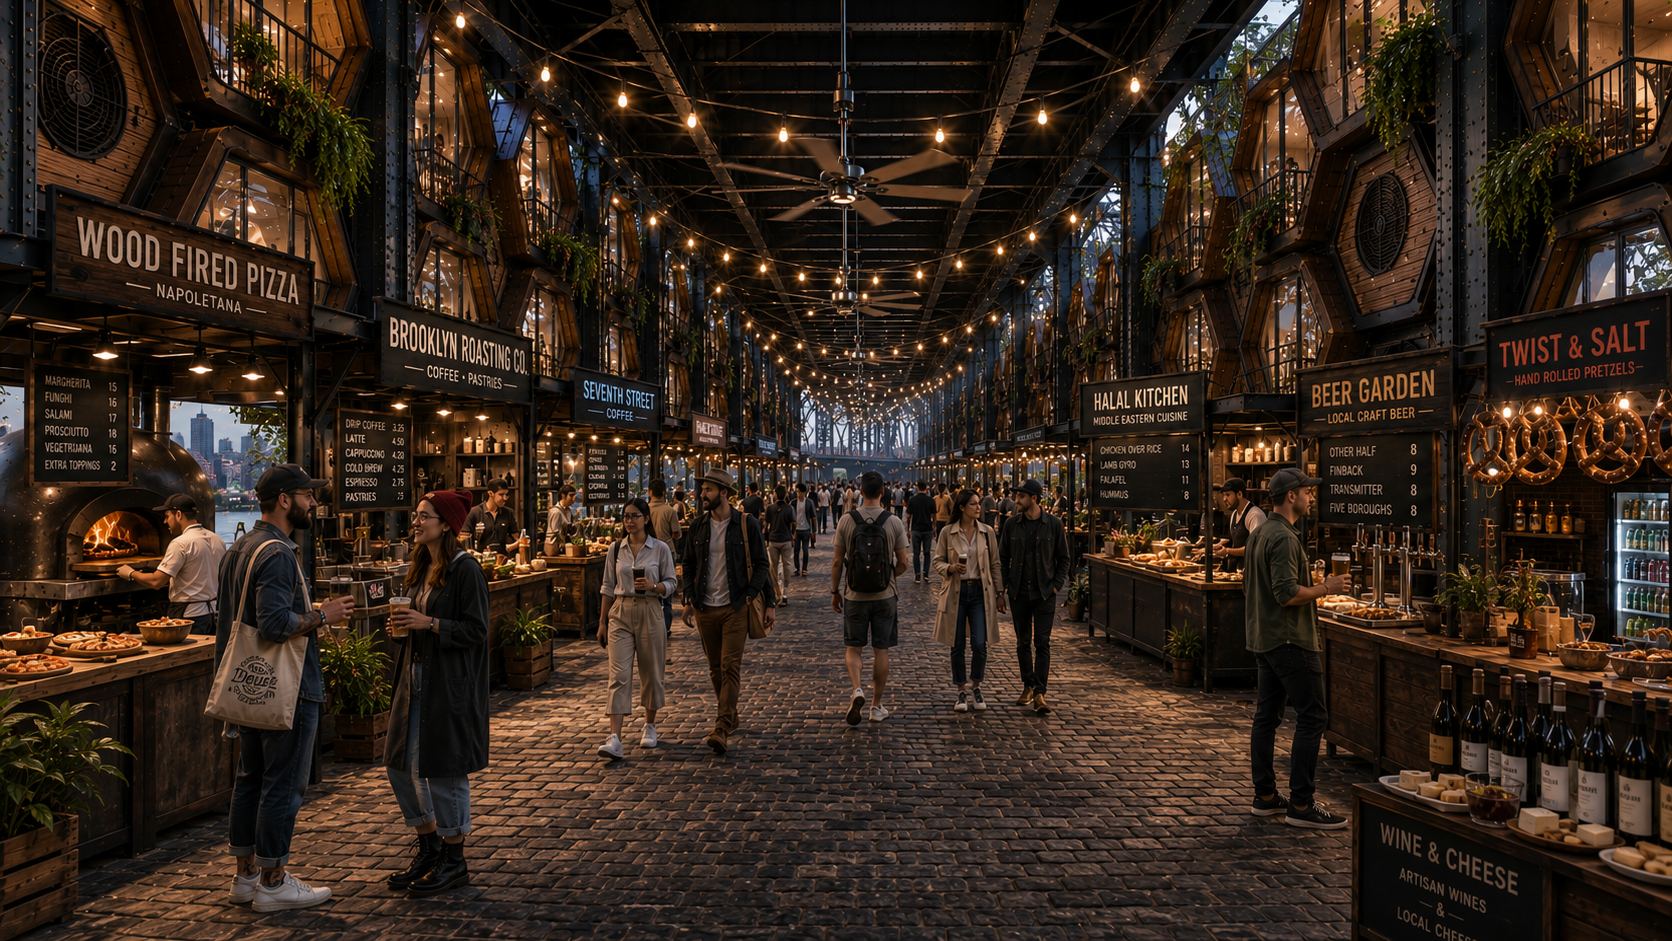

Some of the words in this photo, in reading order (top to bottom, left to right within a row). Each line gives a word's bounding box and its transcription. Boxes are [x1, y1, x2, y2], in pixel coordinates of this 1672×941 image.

[77, 216, 160, 272] WOOD
[172, 242, 238, 290] FIRED
[247, 262, 299, 304] PIZZA
[156, 283, 242, 314] NAPOLETANA
[389, 317, 458, 361] BROOKLYN
[462, 335, 511, 371] ROASTING
[513, 350, 528, 376] CO.
[1500, 333, 1562, 368] TWIST
[1569, 335, 1583, 359] &
[1591, 320, 1650, 357] SALT
[427, 365, 459, 382] COFFEE
[468, 373, 503, 390] PASTRIES
[1514, 372, 1541, 386] HAND
[1543, 368, 1581, 383] ROLLED
[1584, 361, 1635, 379] PRETZELS
[45, 375, 91, 390] MARGHERITA
[108, 382, 117, 392] 15
[1312, 381, 1352, 408] BEER
[1359, 369, 1435, 403] GARDEN
[45, 391, 72, 404] FUNGHI
[583, 380, 623, 405] SEVENTH
[626, 388, 654, 410] STREET
[1094, 389, 1131, 411] HALAL
[1134, 385, 1188, 408] KITCHEN
[45, 408, 72, 420] SALAMI
[109, 413, 117, 423] 17
[606, 408, 634, 421] COFFEE
[1093, 414, 1119, 426] MIDDLE
[1121, 412, 1155, 425] EASTERN
[1157, 411, 1188, 422] CUISINE
[1328, 412, 1355, 424] LOCAL
[1357, 409, 1387, 422] CRAFT
[1390, 407, 1415, 420] BEER
[345, 418, 361, 429] DRIP
[362, 420, 386, 431] COFFEE
[45, 426, 89, 437] PROSCIUTTO
[108, 429, 117, 438] 18
[345, 434, 366, 443] LATTE
[1182, 444, 1190, 453] 14
[1329, 445, 1353, 457] OTHER
[1355, 445, 1376, 457] HALF
[1410, 443, 1417, 455] 8
[45, 460, 67, 470] EXTRA
[69, 460, 101, 471] TOPPINGS
[111, 461, 116, 471] 2
[345, 463, 363, 473] COLD
[364, 463, 383, 473] BREW
[1119, 459, 1136, 470] GYRO
[1182, 460, 1190, 469] 13
[1329, 464, 1363, 476] FINBACK
[1410, 464, 1417, 476] 9
[345, 478, 378, 487] ESPRESSO
[1100, 475, 1126, 484] FALAFEL
[1182, 475, 1189, 485] 11
[345, 492, 376, 502] PASTRIES
[1100, 490, 1129, 499] HUMMUS
[1184, 491, 1190, 500] 8
[1329, 484, 1383, 496] TRANSMITTER
[1410, 484, 1417, 497] 8
[1329, 503, 1345, 514] FIVE
[1347, 503, 1392, 516] BOROUGHS
[1410, 504, 1417, 517] 8
[1380, 822, 1422, 858] WINE
[1428, 841, 1440, 865] &
[1446, 847, 1519, 896] CHEESE
[1400, 867, 1445, 896] ARTISAN
[1449, 886, 1487, 914] WINES
[1436, 902, 1445, 917] &
[1397, 906, 1431, 933] LOCAL
